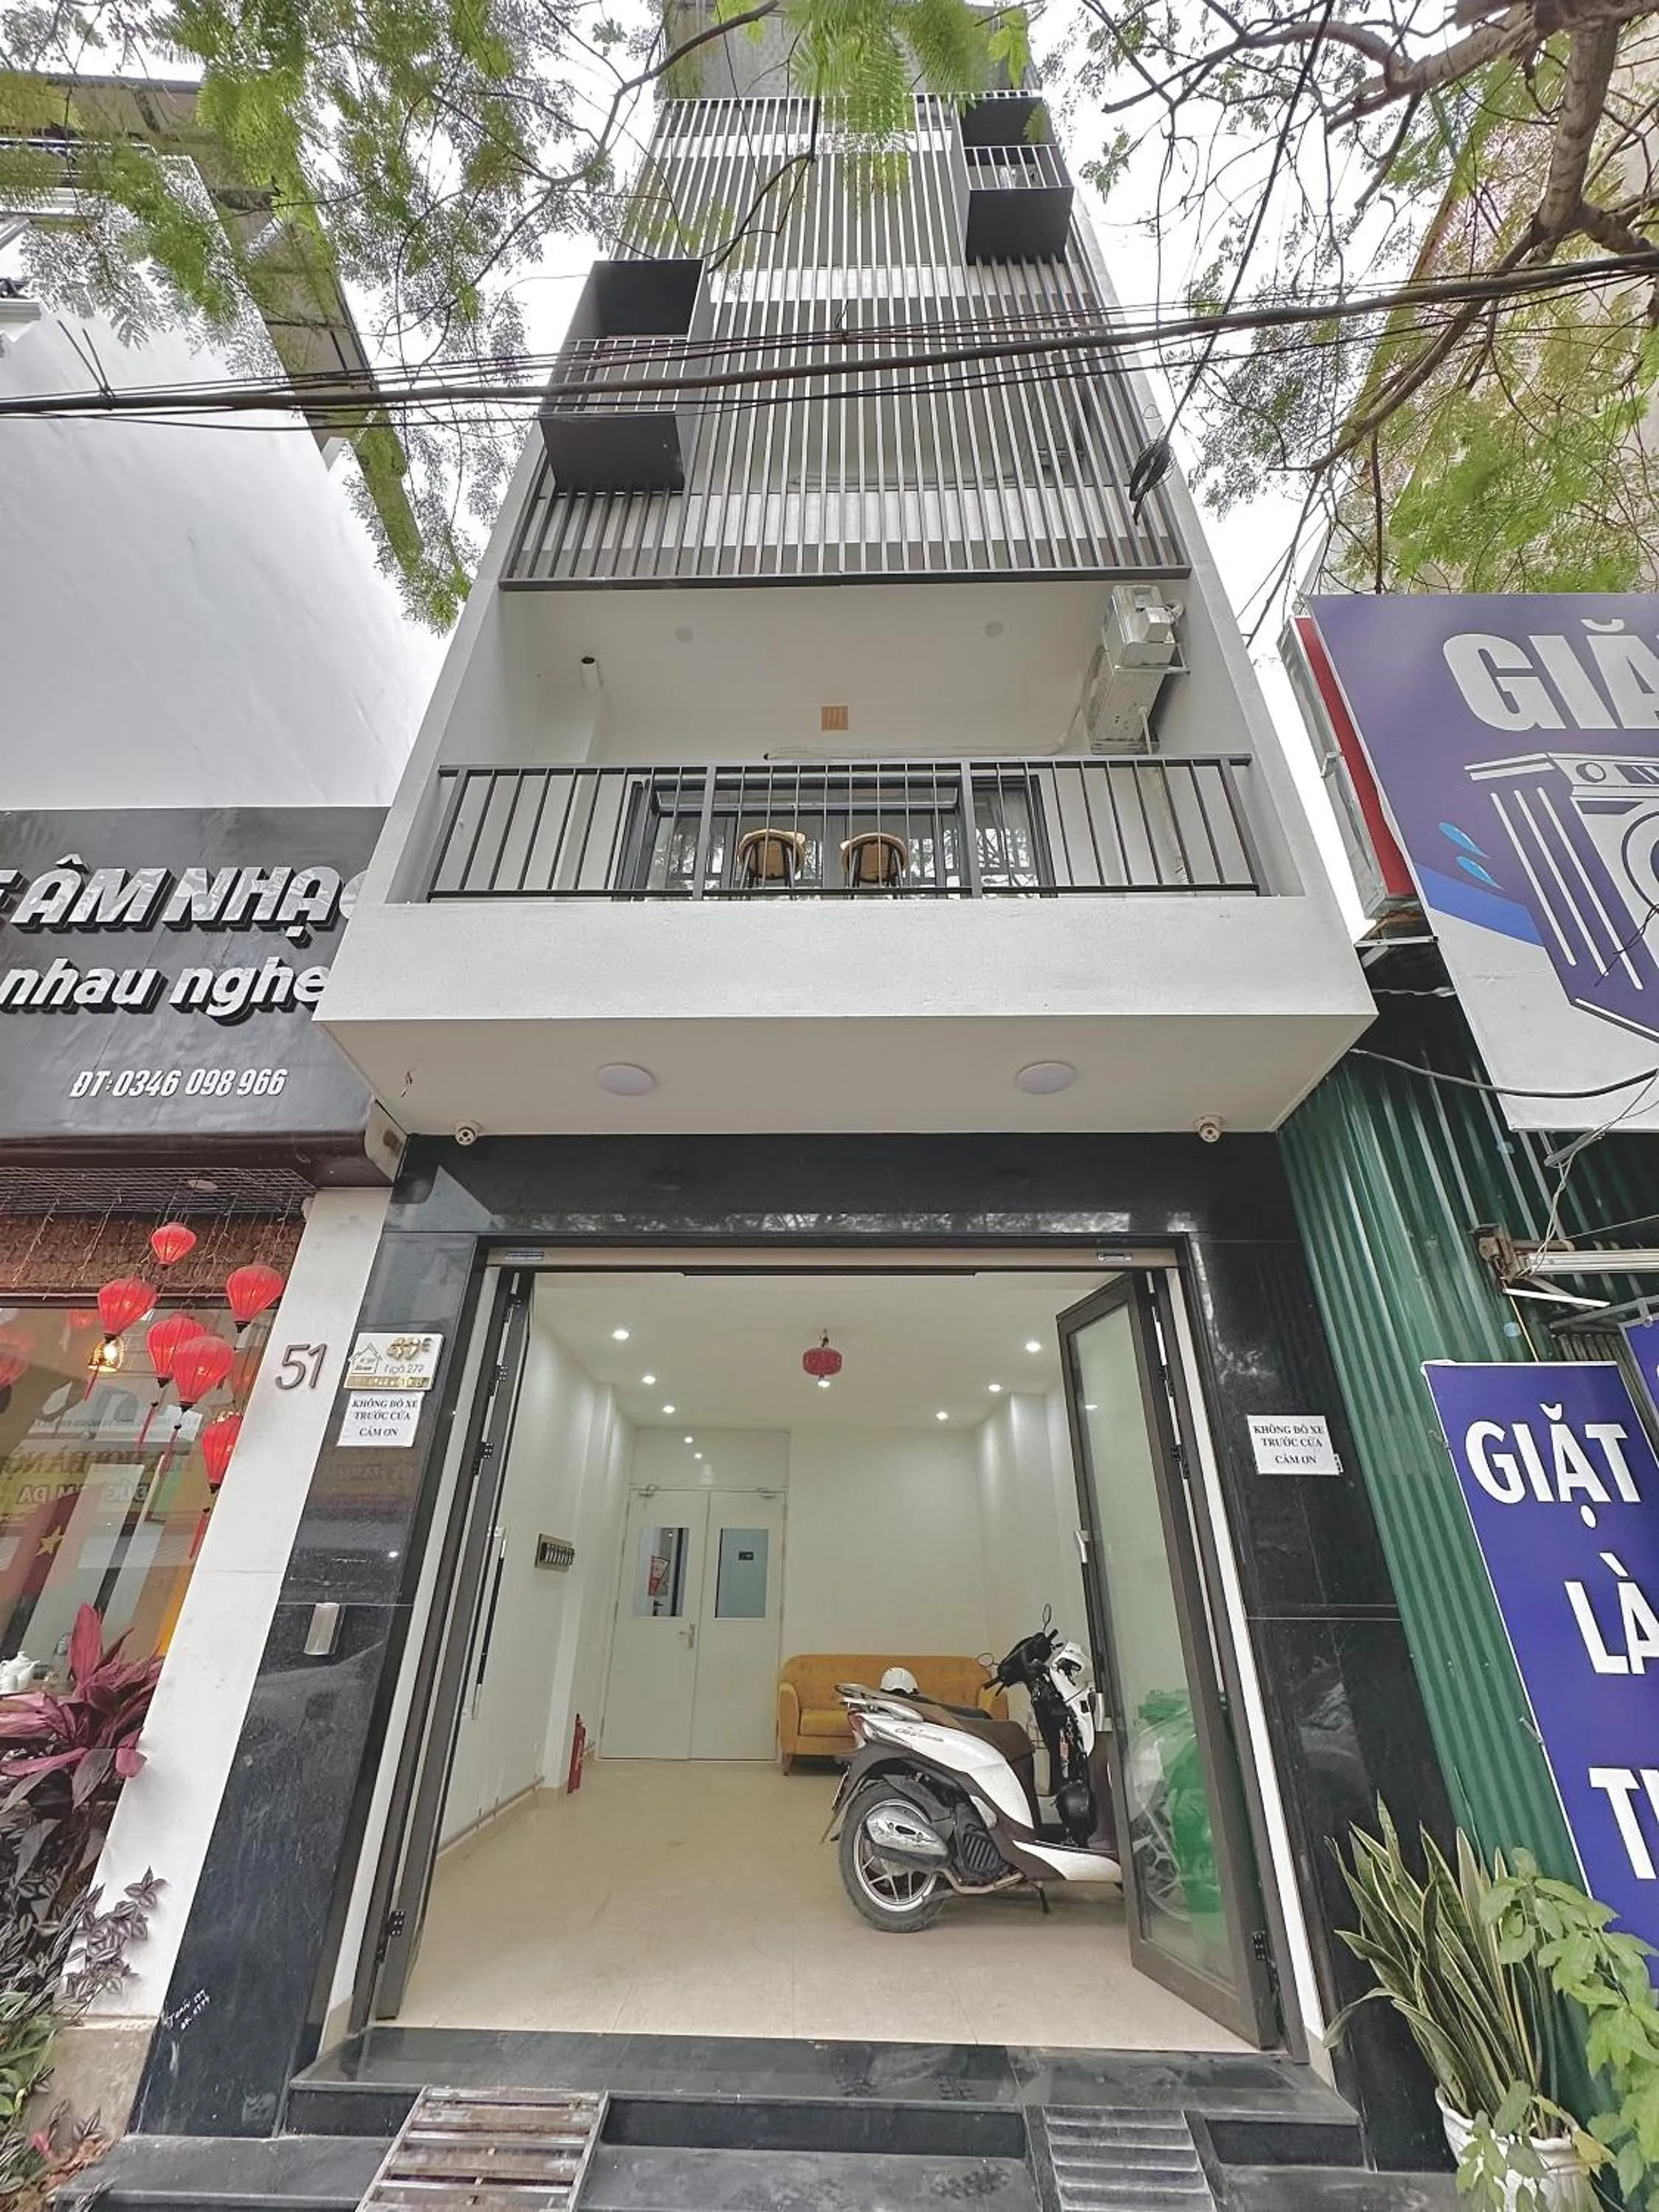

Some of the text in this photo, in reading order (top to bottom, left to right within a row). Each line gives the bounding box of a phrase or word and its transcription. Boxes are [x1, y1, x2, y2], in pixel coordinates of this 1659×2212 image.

[10, 853, 167, 924] ÂM
[0, 956, 331, 1017] nhau nghe
[184, 1068, 237, 1096] 098
[237, 1068, 289, 1096] 966
[275, 1343, 328, 1391] 51
[352, 1398, 388, 1408] KHÔNG
[406, 1399, 418, 1408] XE
[1253, 1423, 1291, 1435] KHÔNG
[1310, 1425, 1325, 1434] XE
[1261, 1436, 1298, 1447] TRƯỚC
[1465, 1403, 1643, 1529] GIẶT
[1564, 1552, 1659, 1675] LÀ
